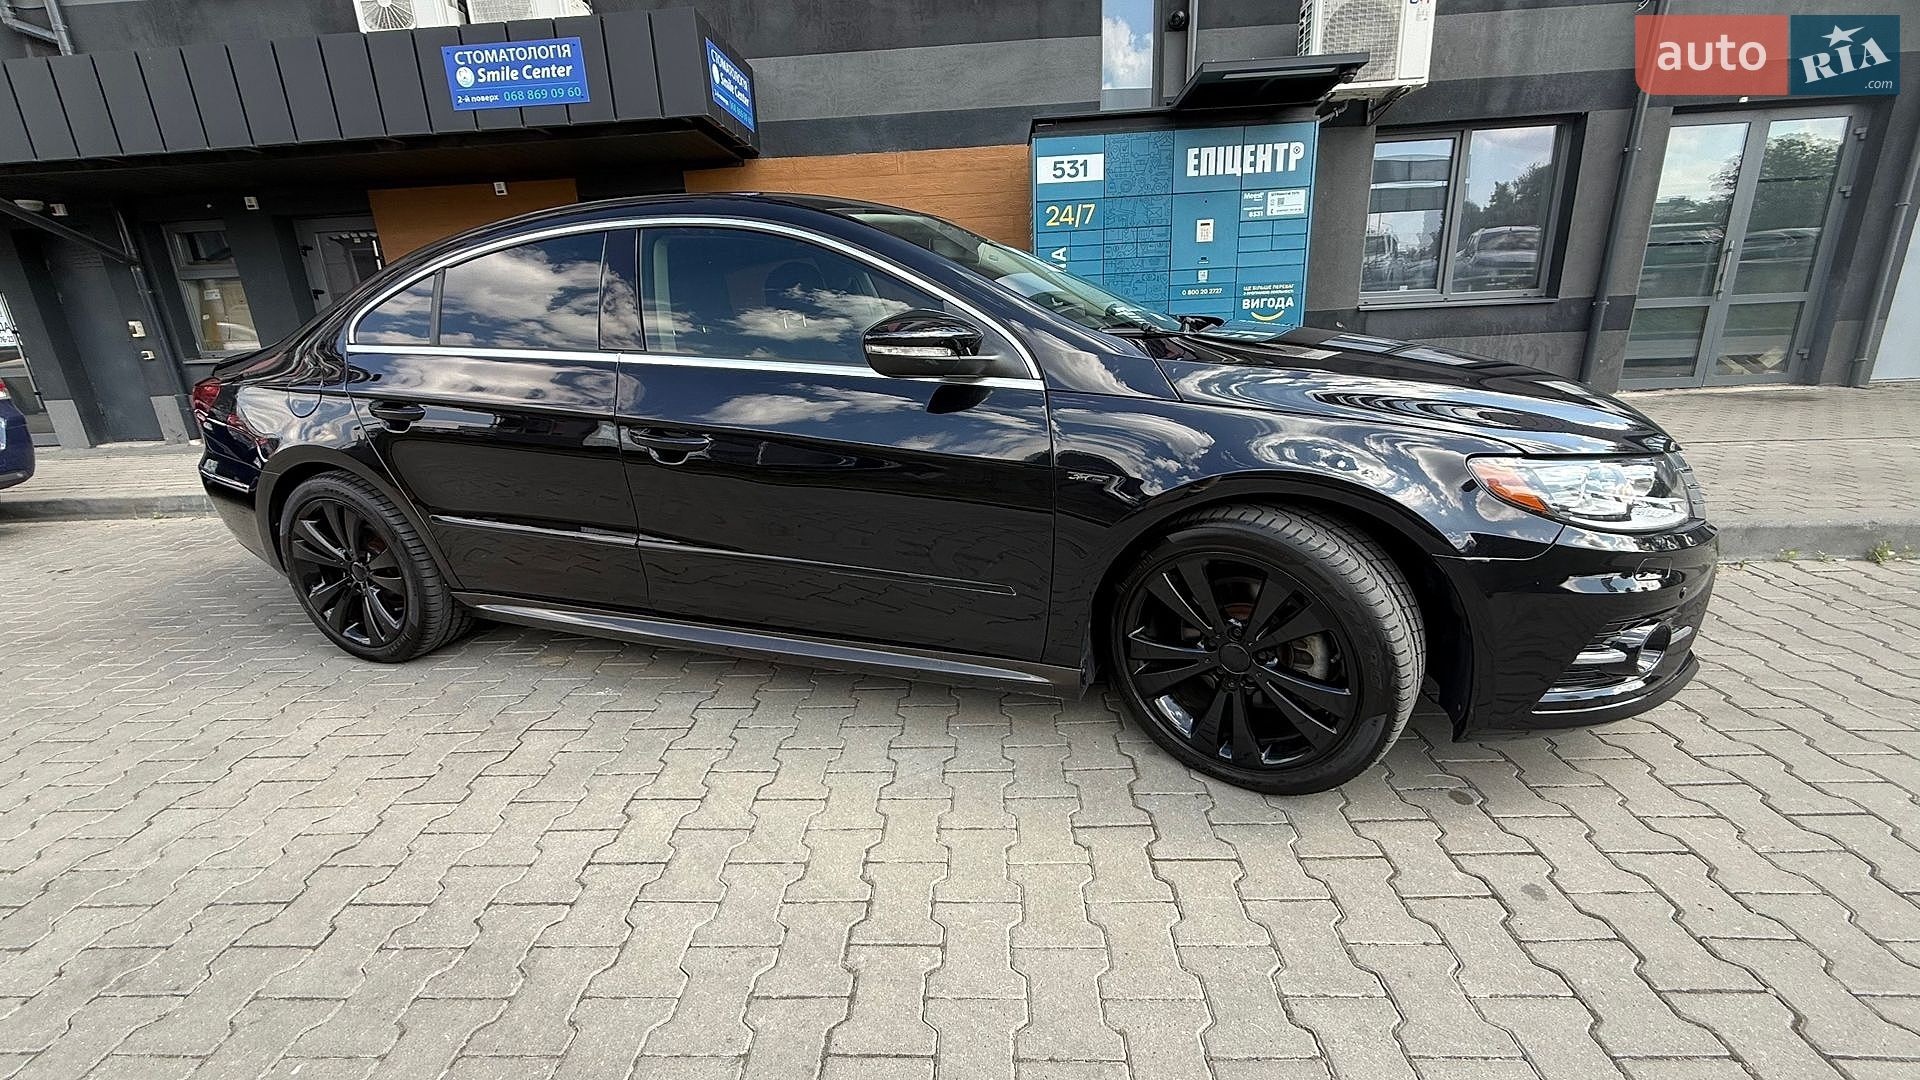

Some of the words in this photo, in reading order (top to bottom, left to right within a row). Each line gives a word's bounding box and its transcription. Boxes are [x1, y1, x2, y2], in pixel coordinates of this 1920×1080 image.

[454, 43, 572, 66] СТОМАТОЛОГІЯ
[477, 67, 520, 83] Smile
[522, 64, 573, 80] Center
[503, 90, 525, 102] 068
[527, 89, 548, 100] 869
[550, 87, 565, 98] 09
[567, 86, 582, 97] 60
[1052, 159, 1089, 179] 531
[1186, 141, 1305, 177] ЕПІЦЕНТР
[1045, 203, 1096, 228] 24/7
[1242, 296, 1295, 310] ВИГОДА
